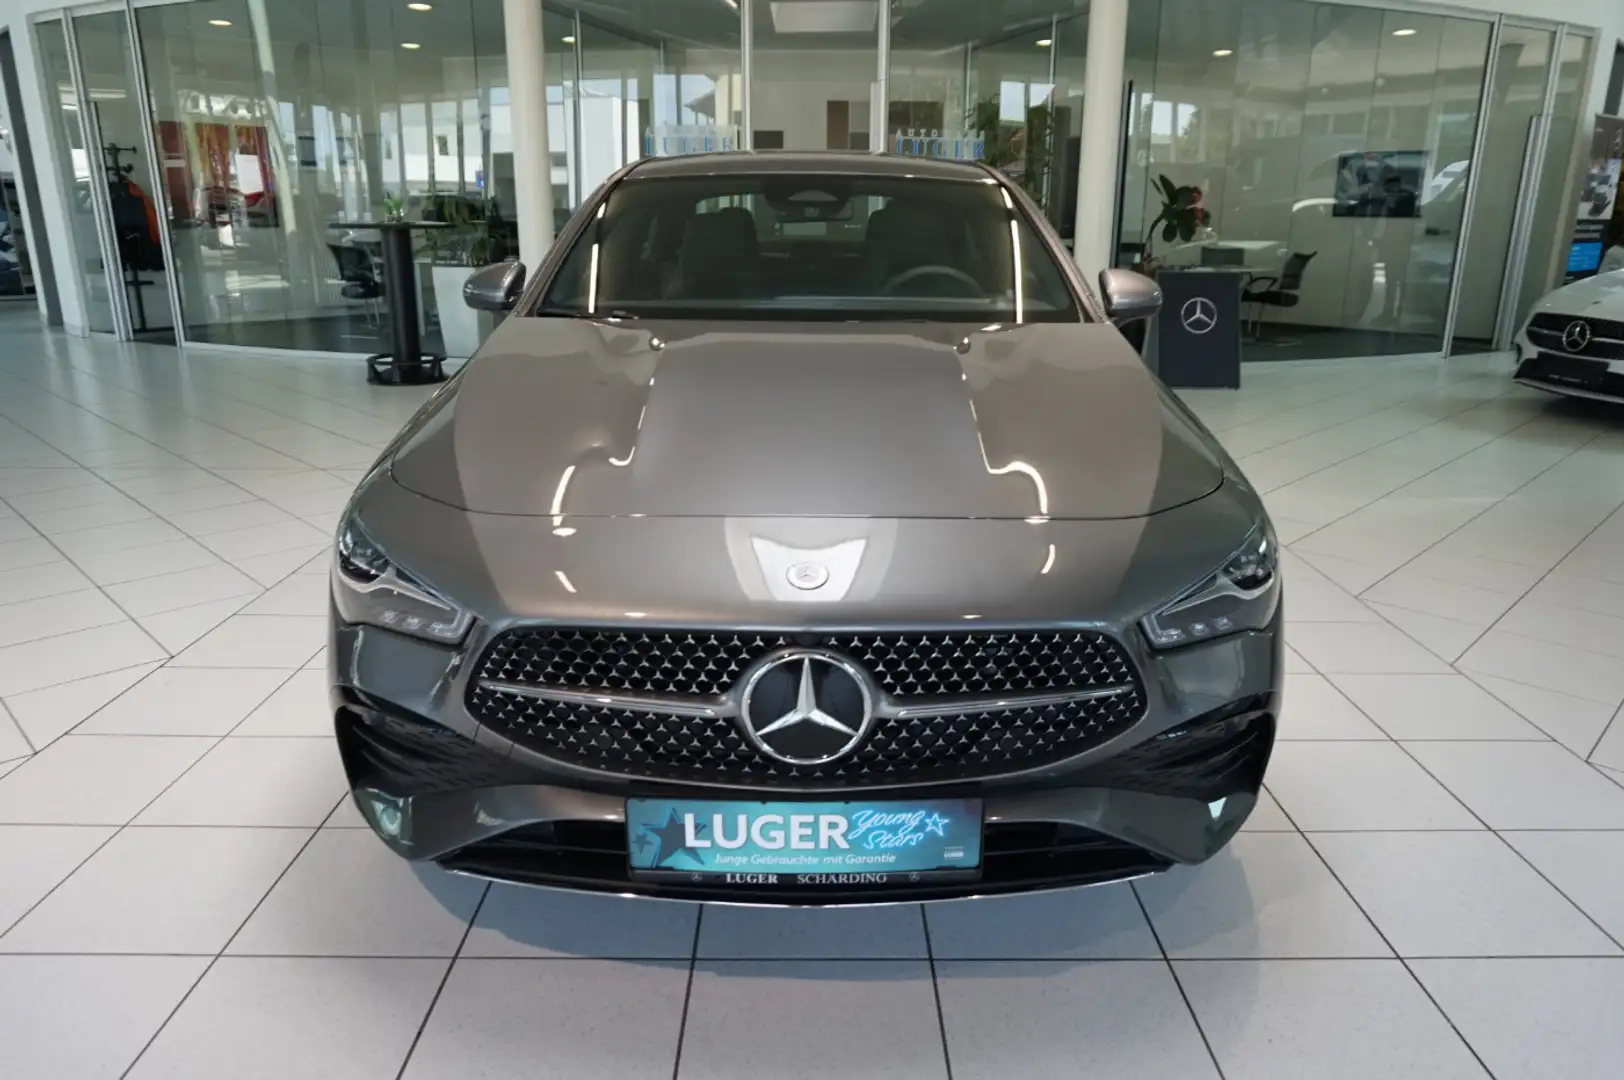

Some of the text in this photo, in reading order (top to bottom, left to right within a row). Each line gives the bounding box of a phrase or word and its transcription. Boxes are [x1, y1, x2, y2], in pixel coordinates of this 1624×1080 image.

[684, 812, 850, 850] LUGER
[848, 809, 926, 840] Young
[862, 830, 925, 850] Stars
[714, 852, 897, 866] Junge Gebrauchte mit Garantie
[725, 872, 779, 884] LUGER
